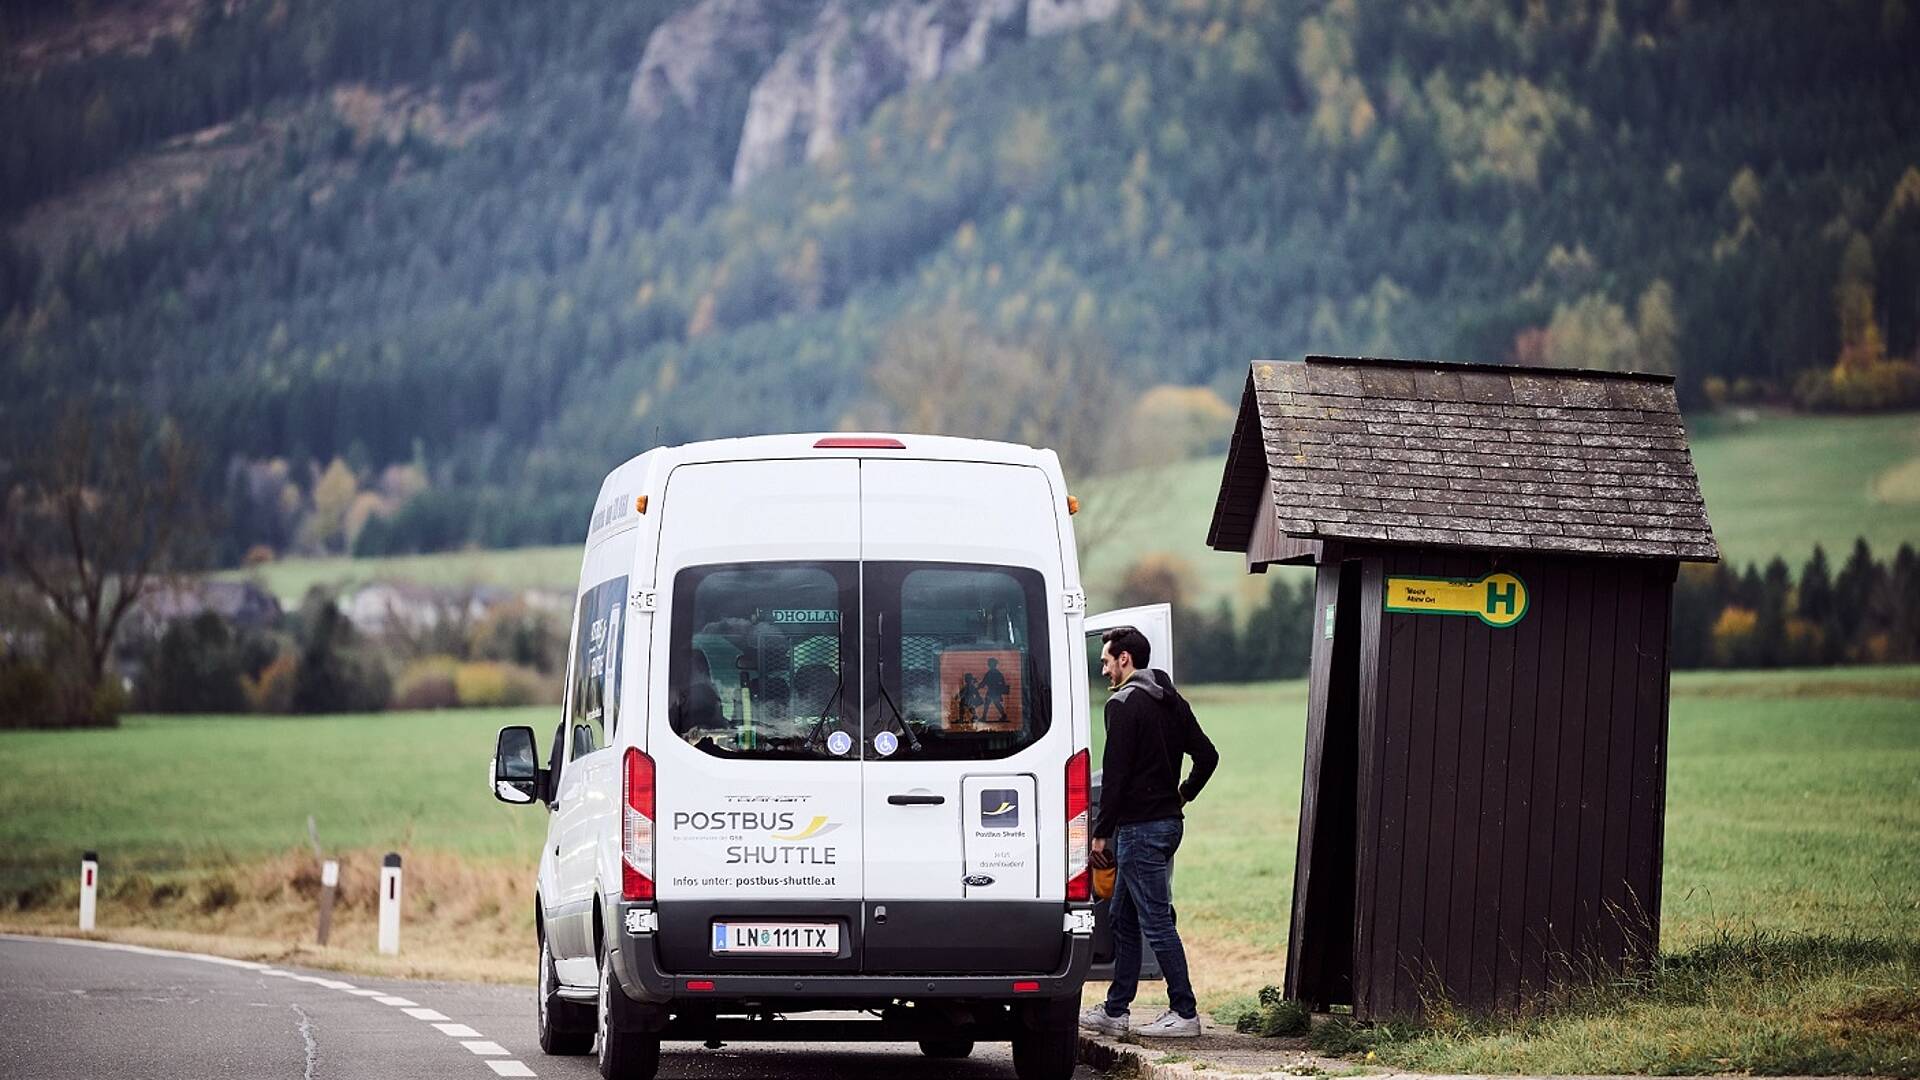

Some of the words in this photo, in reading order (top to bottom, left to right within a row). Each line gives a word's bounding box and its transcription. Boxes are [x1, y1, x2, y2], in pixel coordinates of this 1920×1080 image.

[1486, 582, 1516, 615] H
[673, 812, 794, 831] POSTBUS
[726, 846, 836, 864] SHUTTLE
[673, 876, 698, 887] Infos
[701, 877, 733, 887] unter:
[736, 875, 836, 889] postbus-shuttle.at
[736, 928, 759, 947] LN
